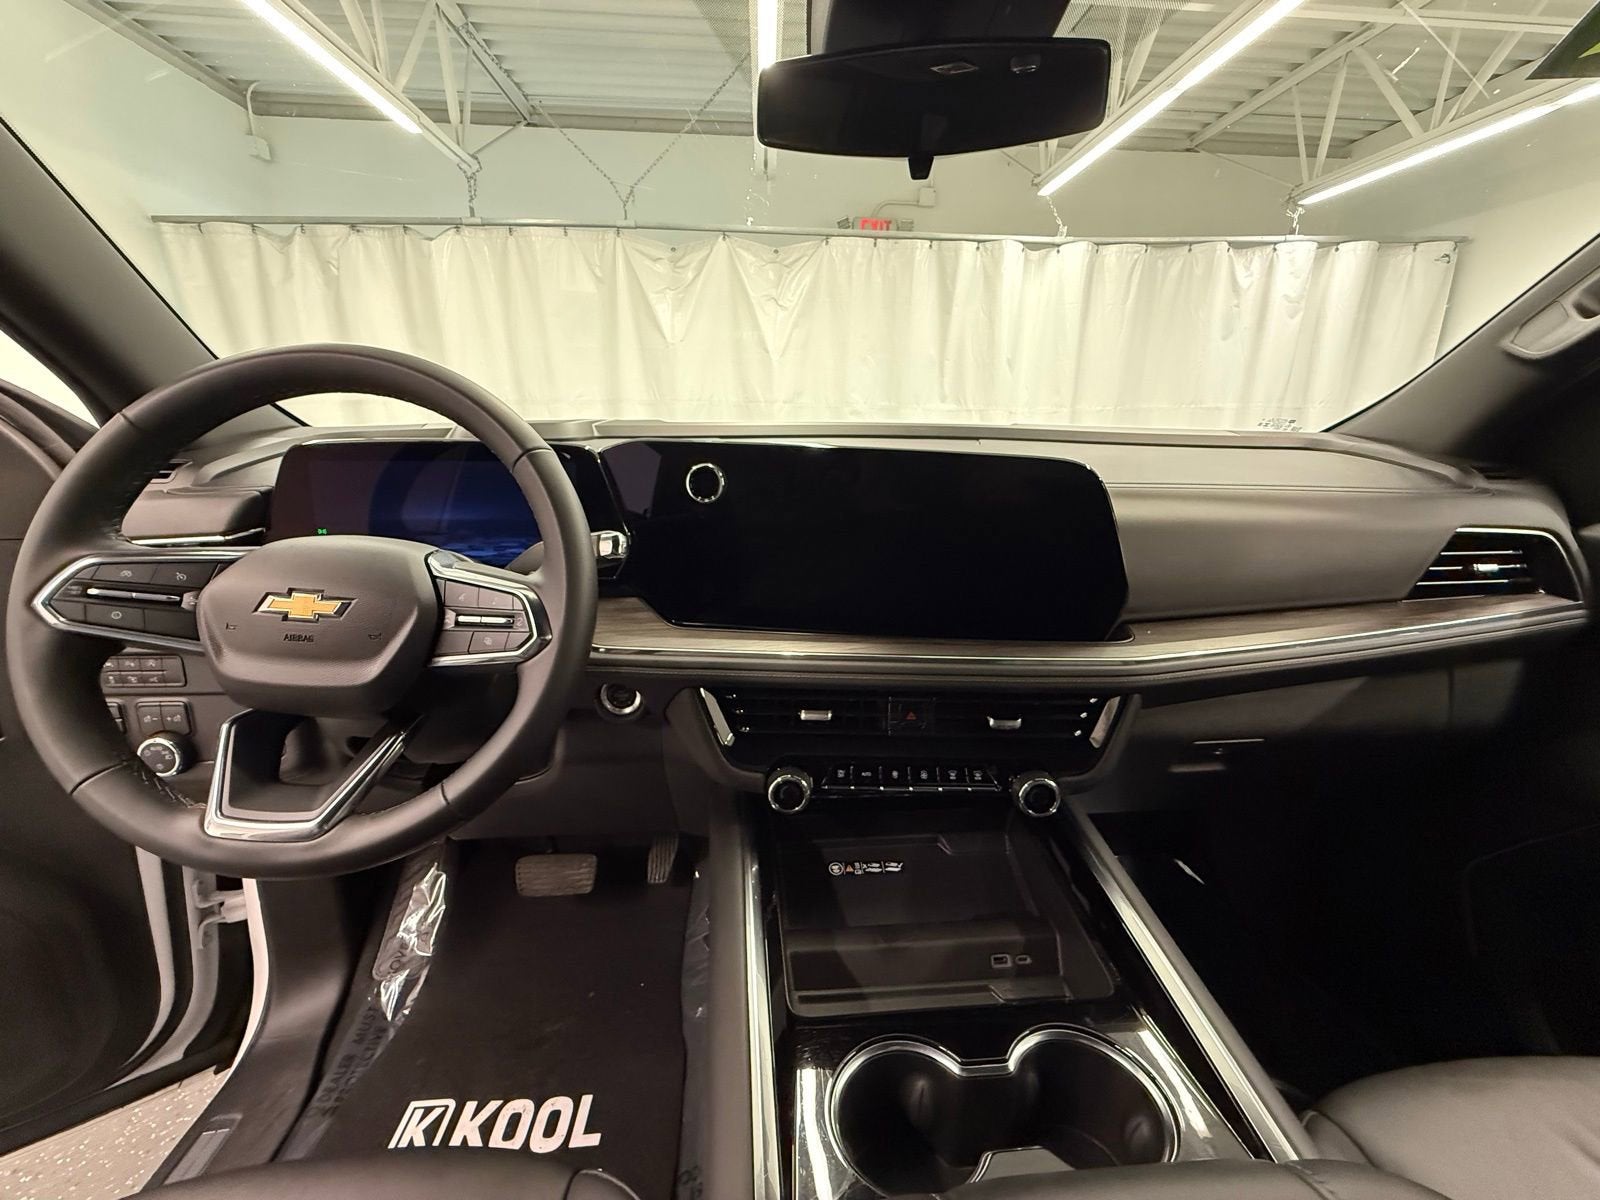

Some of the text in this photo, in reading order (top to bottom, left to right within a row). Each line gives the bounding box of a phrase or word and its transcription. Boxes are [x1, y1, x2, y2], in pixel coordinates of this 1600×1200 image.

[860, 217, 892, 231] EXIT
[283, 632, 315, 643] AIRBAG
[351, 1006, 379, 1045] MUST
[449, 1095, 602, 1153] KOOL
